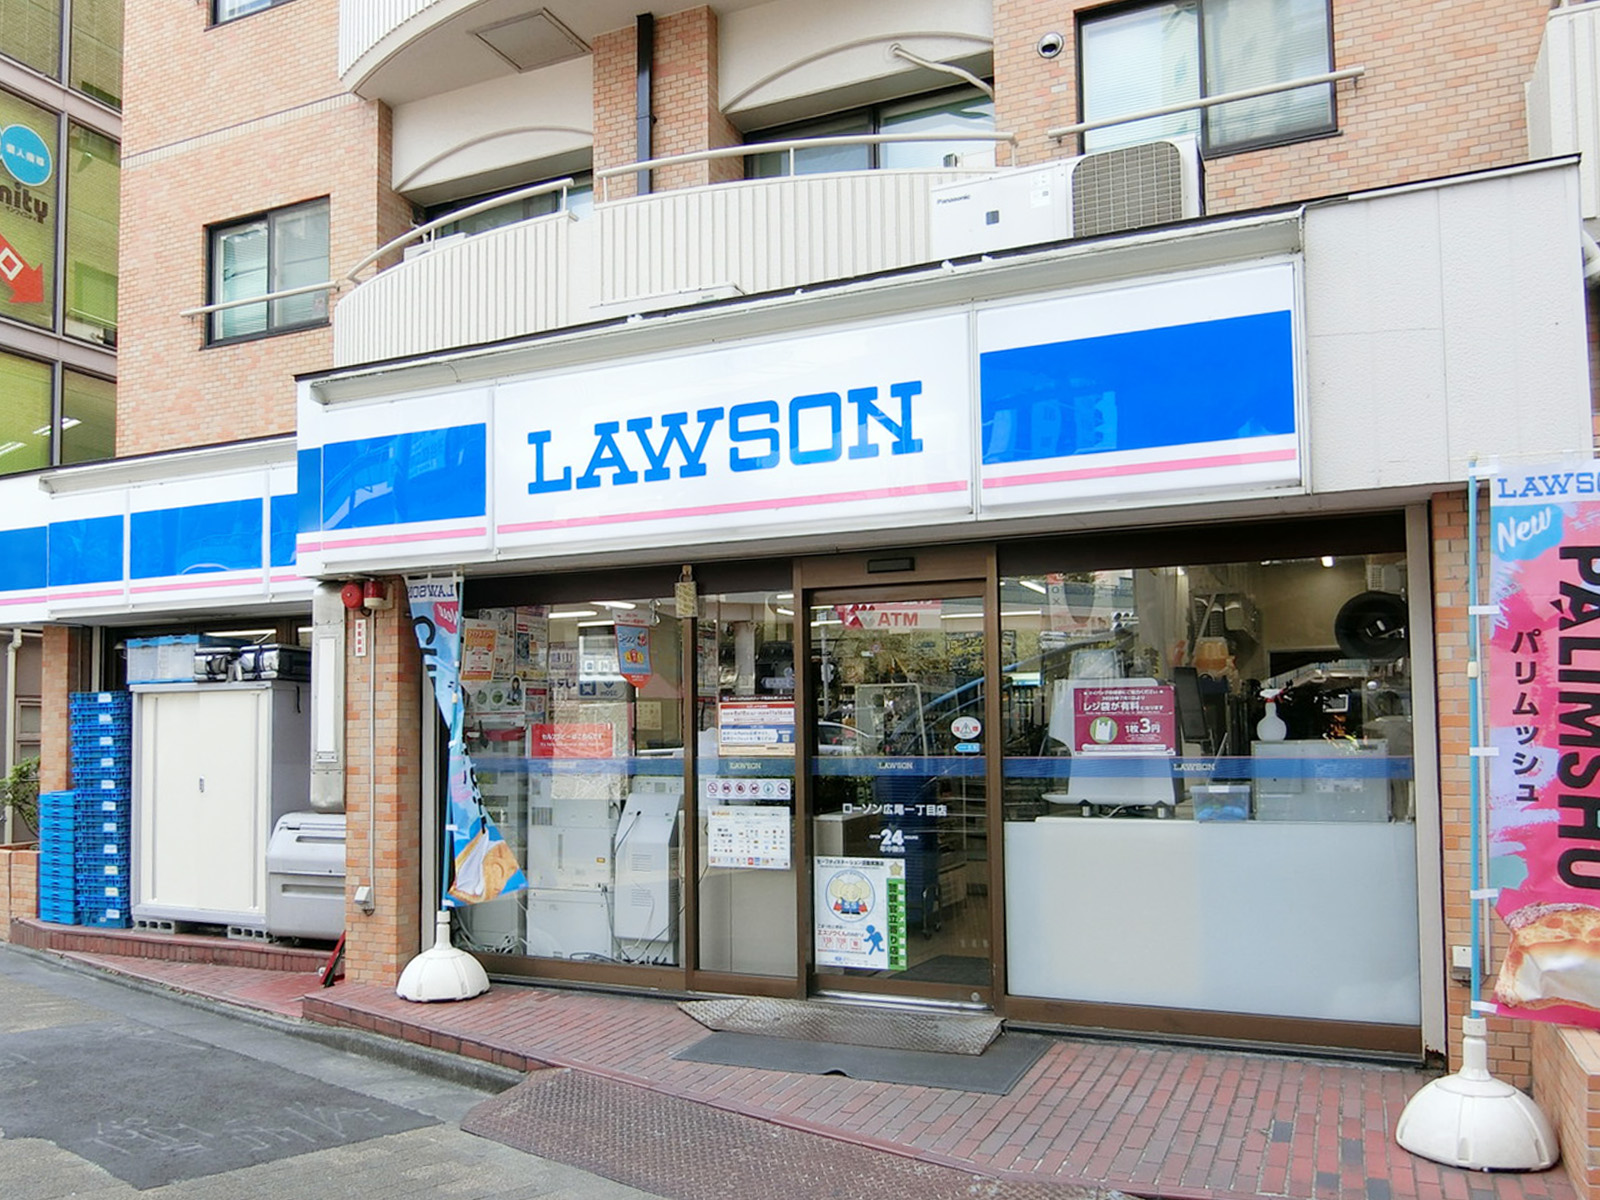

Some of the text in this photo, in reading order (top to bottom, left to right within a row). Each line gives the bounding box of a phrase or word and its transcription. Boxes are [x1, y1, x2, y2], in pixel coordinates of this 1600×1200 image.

[937, 194, 970, 205] Panasonic
[527, 380, 923, 495] LAWSON
[1497, 472, 1600, 498] LAWS
[1497, 507, 1552, 553] New
[877, 612, 918, 627] ATM
[1083, 701, 1164, 711] レジ袋が有料になります
[1510, 627, 1542, 802] パリムッシュ
[878, 762, 913, 770] LAWSON
[1173, 763, 1216, 771] LAWSON
[842, 803, 948, 817] ローソン広尾一丁目店
[880, 828, 905, 846] 24
